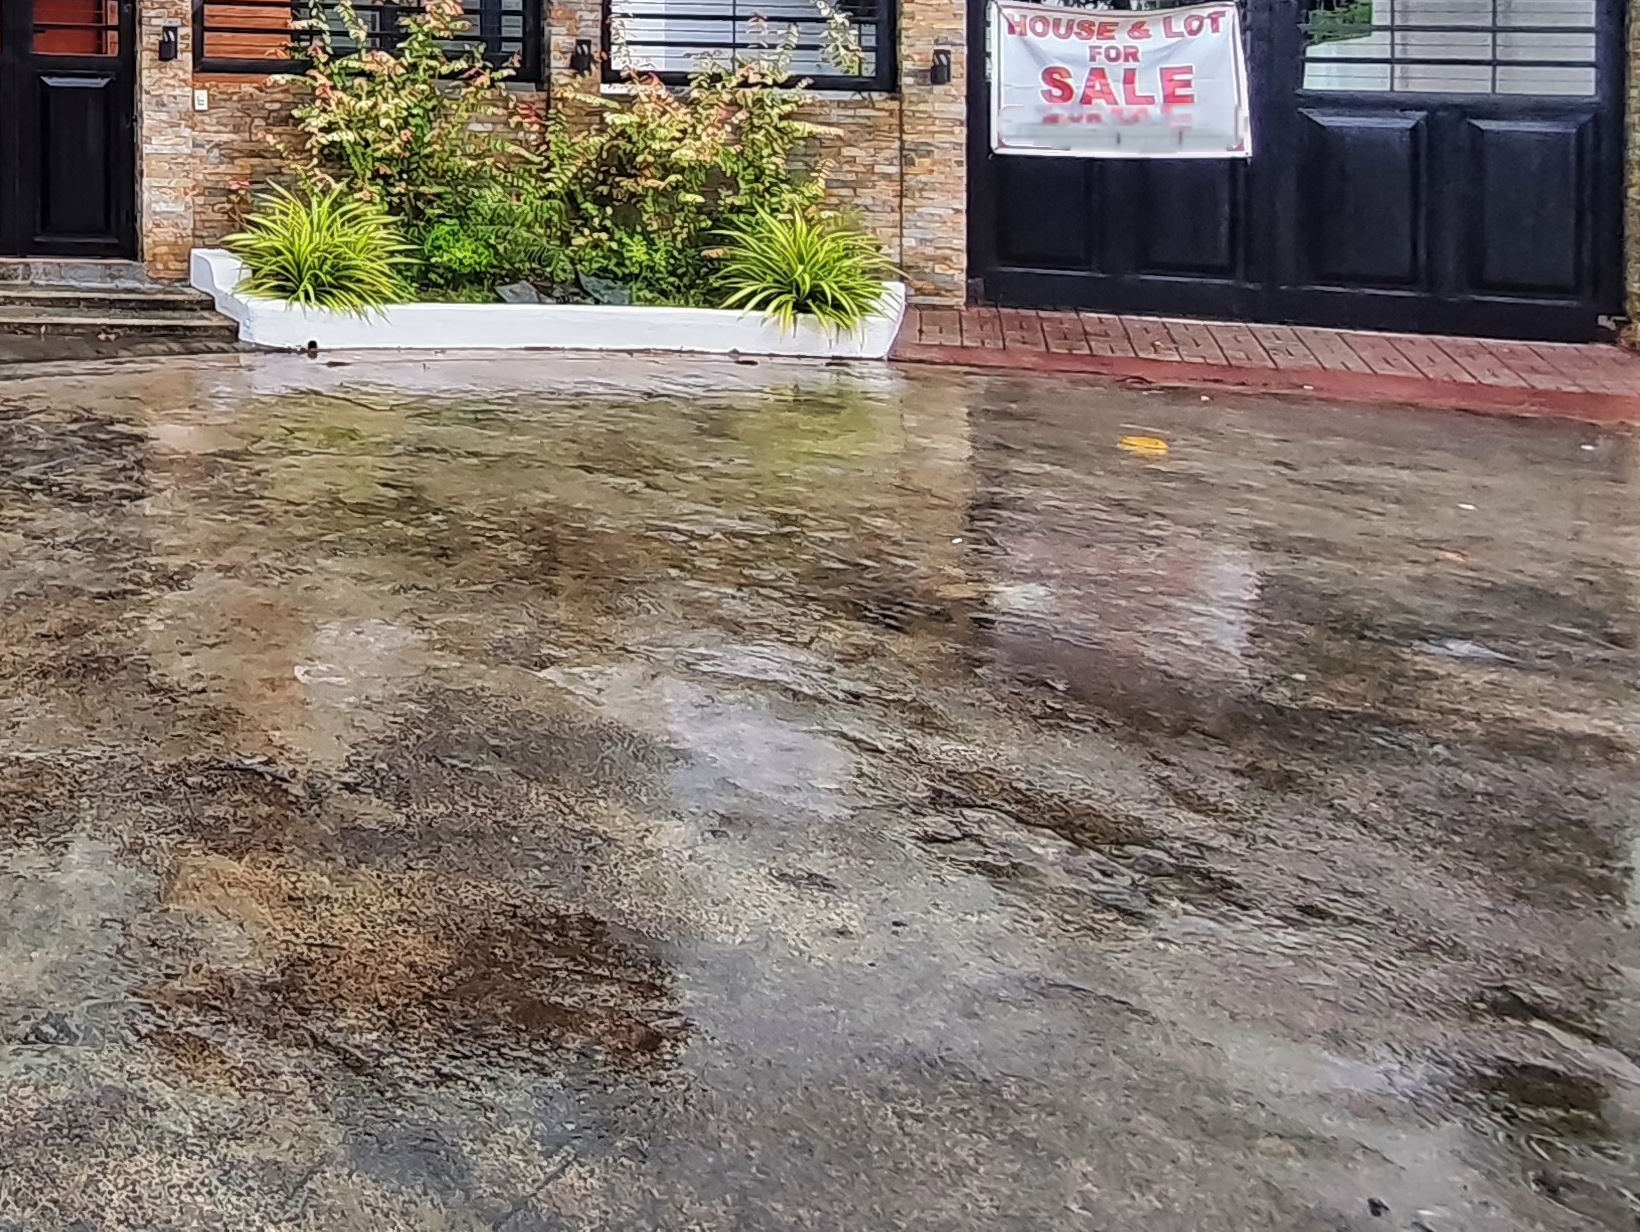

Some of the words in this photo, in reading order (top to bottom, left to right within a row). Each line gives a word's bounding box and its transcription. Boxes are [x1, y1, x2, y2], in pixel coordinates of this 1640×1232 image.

[1007, 14, 1119, 40] HOUSE
[1127, 20, 1152, 40] &
[1163, 10, 1226, 38] LOT
[1088, 45, 1140, 63] FOR
[1040, 65, 1195, 106] SALE
